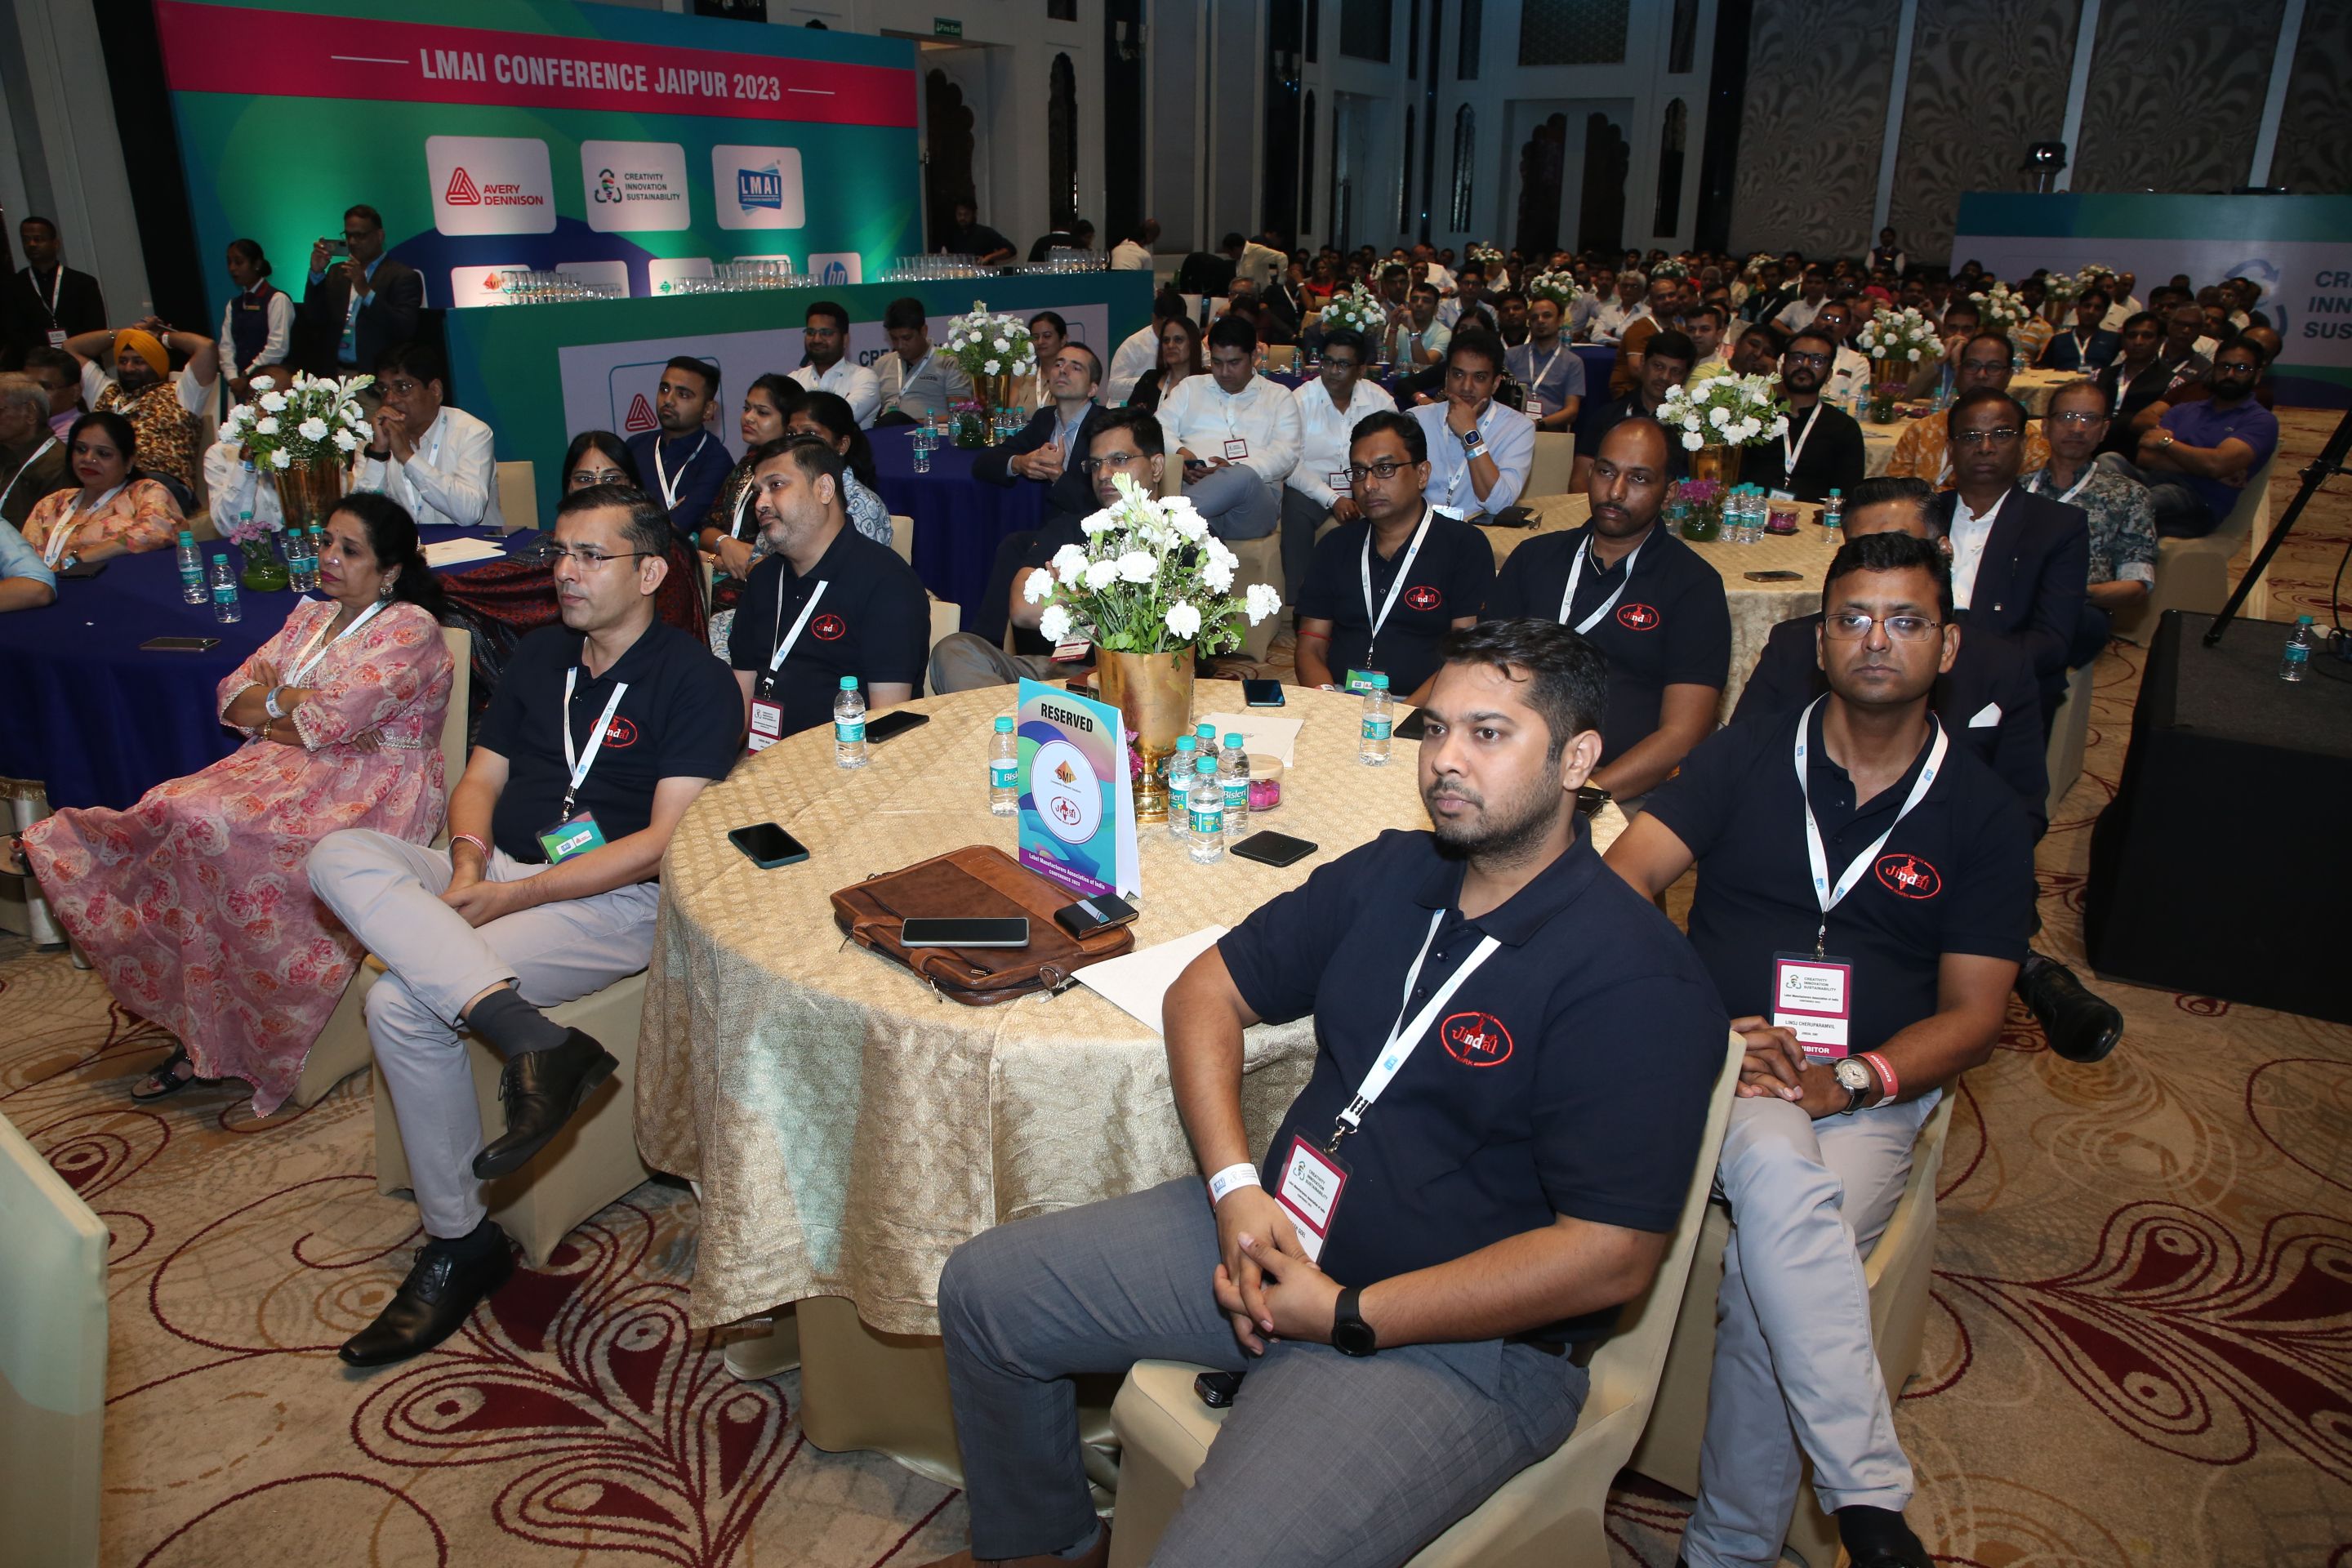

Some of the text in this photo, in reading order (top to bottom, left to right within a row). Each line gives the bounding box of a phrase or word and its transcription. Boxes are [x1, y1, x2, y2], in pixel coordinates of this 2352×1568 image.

[419, 49, 781, 101] LMAI CONFERENCE JAIPUR 2023
[483, 184, 520, 194] AVERY
[741, 176, 779, 194] LMAI
[484, 196, 544, 205] DENNISON
[626, 193, 680, 201] SUSTAINABILITY
[2315, 271, 2352, 287] CR
[1041, 703, 1093, 733] RESERVED
[606, 728, 630, 740] ndal
[1004, 771, 1018, 781] Bisl
[1057, 769, 1071, 783] SMI
[1224, 788, 1246, 798] Bisleri
[1029, 853, 1039, 862] Label
[1040, 857, 1067, 873] Manufacturers
[1067, 869, 1089, 883] Association
[1095, 881, 1105, 890] India
[1049, 869, 1071, 882] CONFERENCE
[1885, 865, 1929, 890] Jindal
[1452, 1026, 1497, 1055] Jindal
[1802, 1046, 1830, 1054] IBITOR
